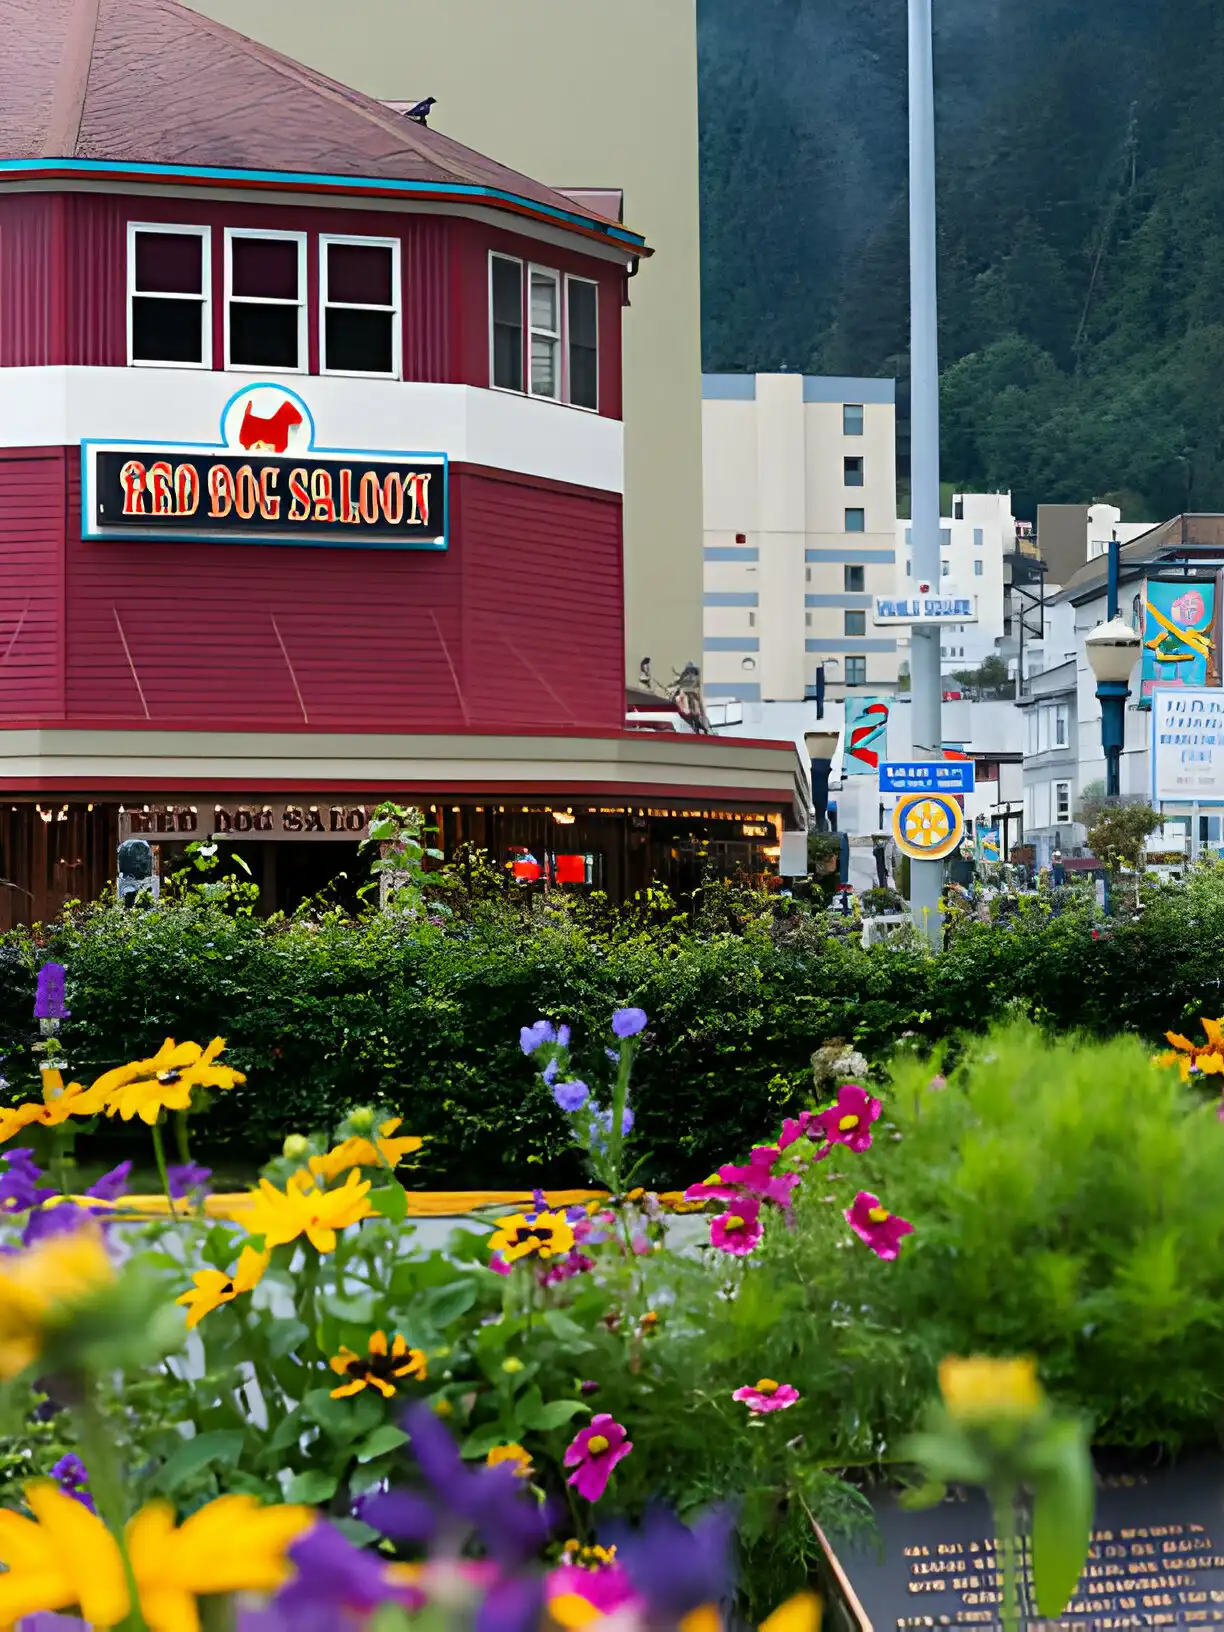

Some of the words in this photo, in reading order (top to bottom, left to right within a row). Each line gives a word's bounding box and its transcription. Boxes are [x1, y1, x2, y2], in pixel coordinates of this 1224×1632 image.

[208, 464, 281, 521] DOG
[288, 467, 431, 526] SALOON
[283, 806, 376, 832] SALO
